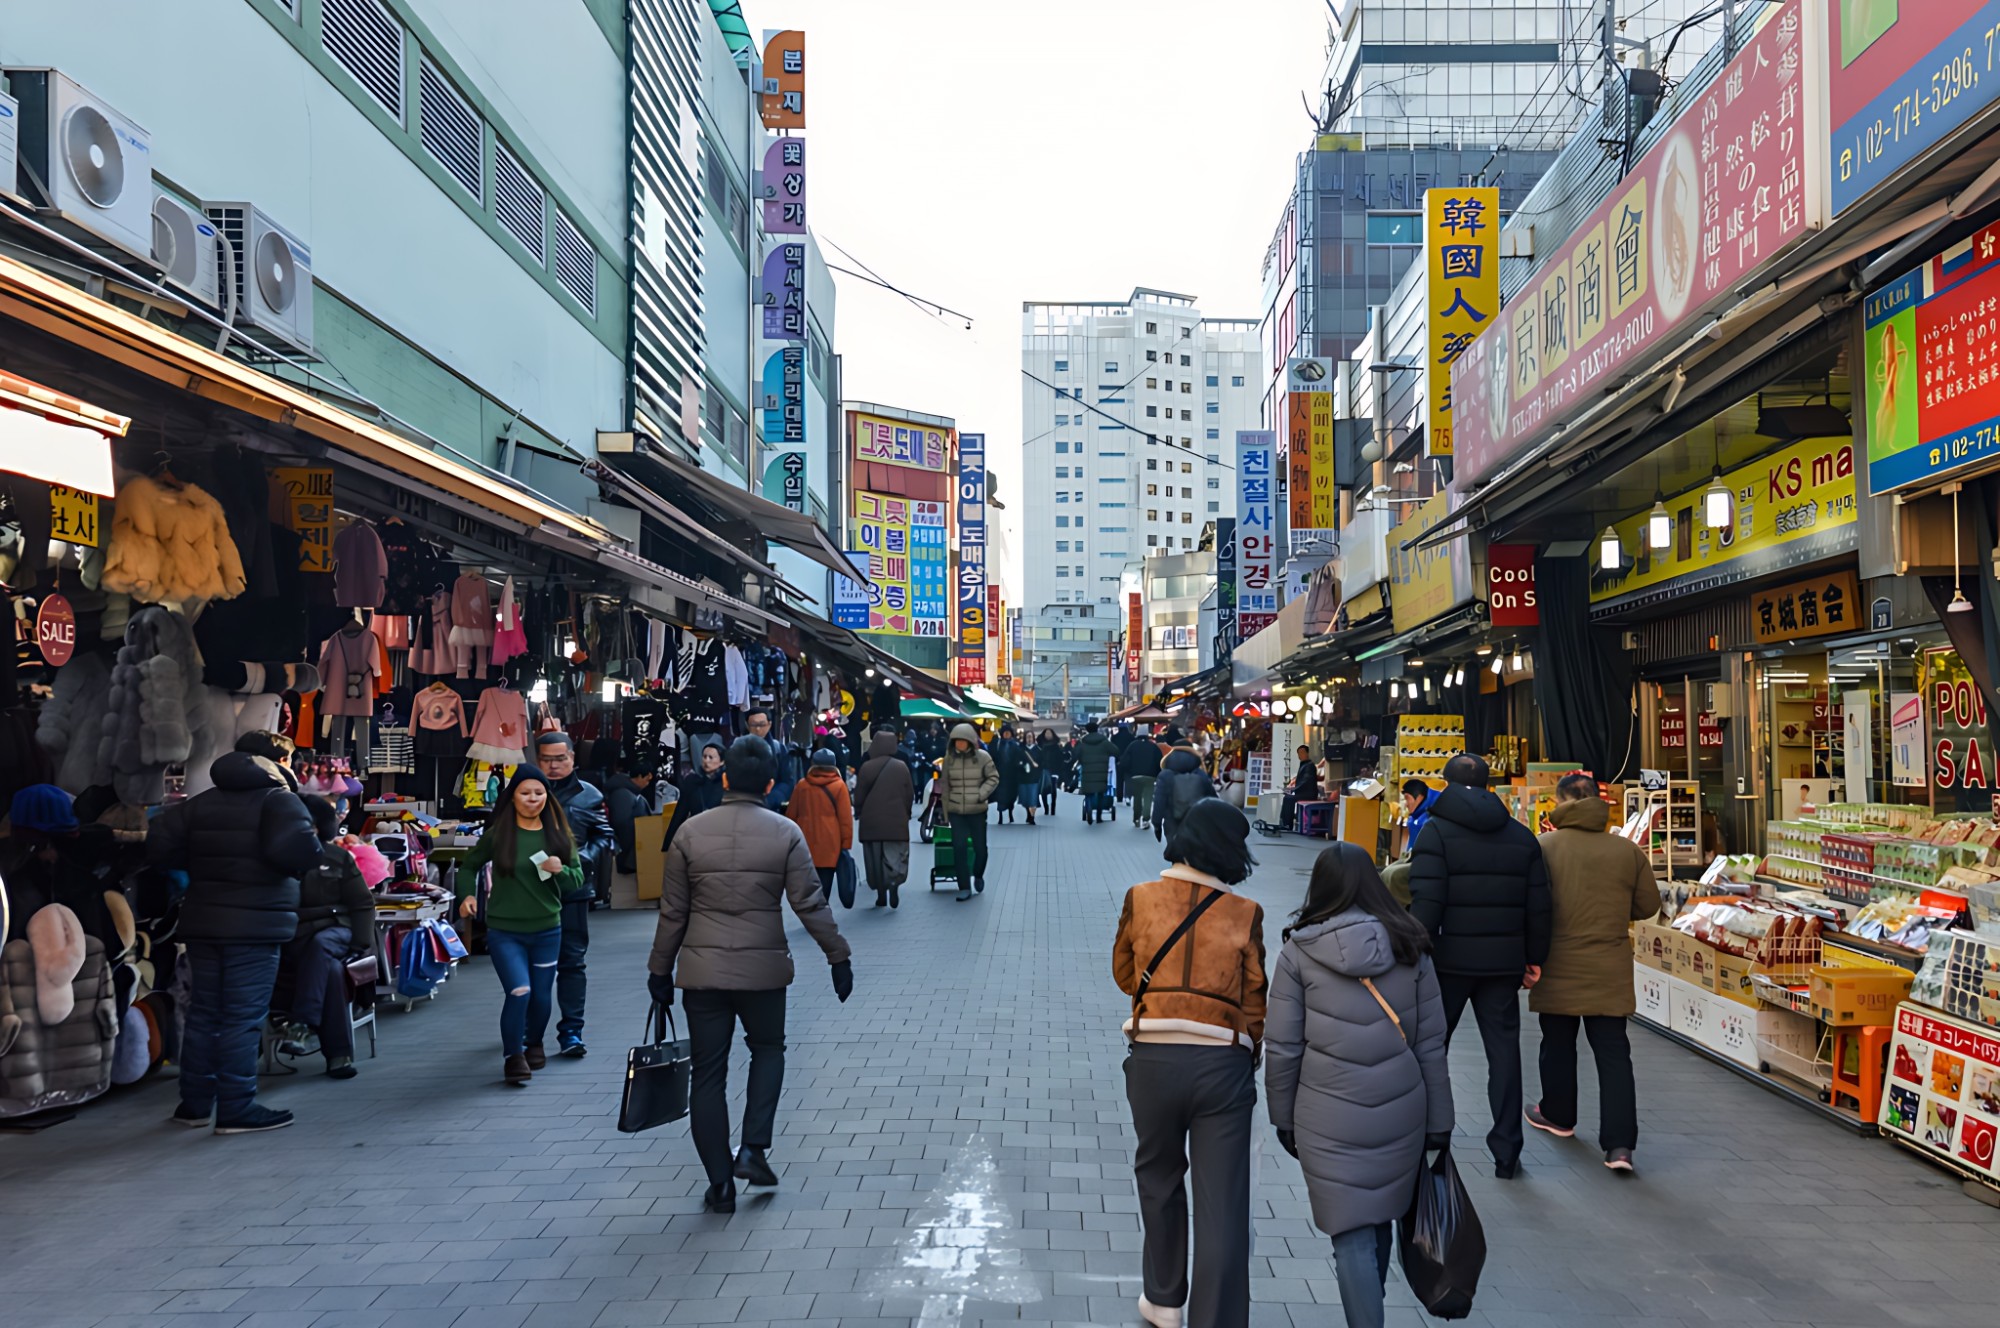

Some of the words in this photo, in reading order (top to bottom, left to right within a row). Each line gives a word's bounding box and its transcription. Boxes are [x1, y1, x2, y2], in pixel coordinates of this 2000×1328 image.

[784, 246, 803, 334] 액세서리
[1768, 456, 1802, 504] KS
[1491, 591, 1517, 609] On
[41, 620, 75, 645] SALE
